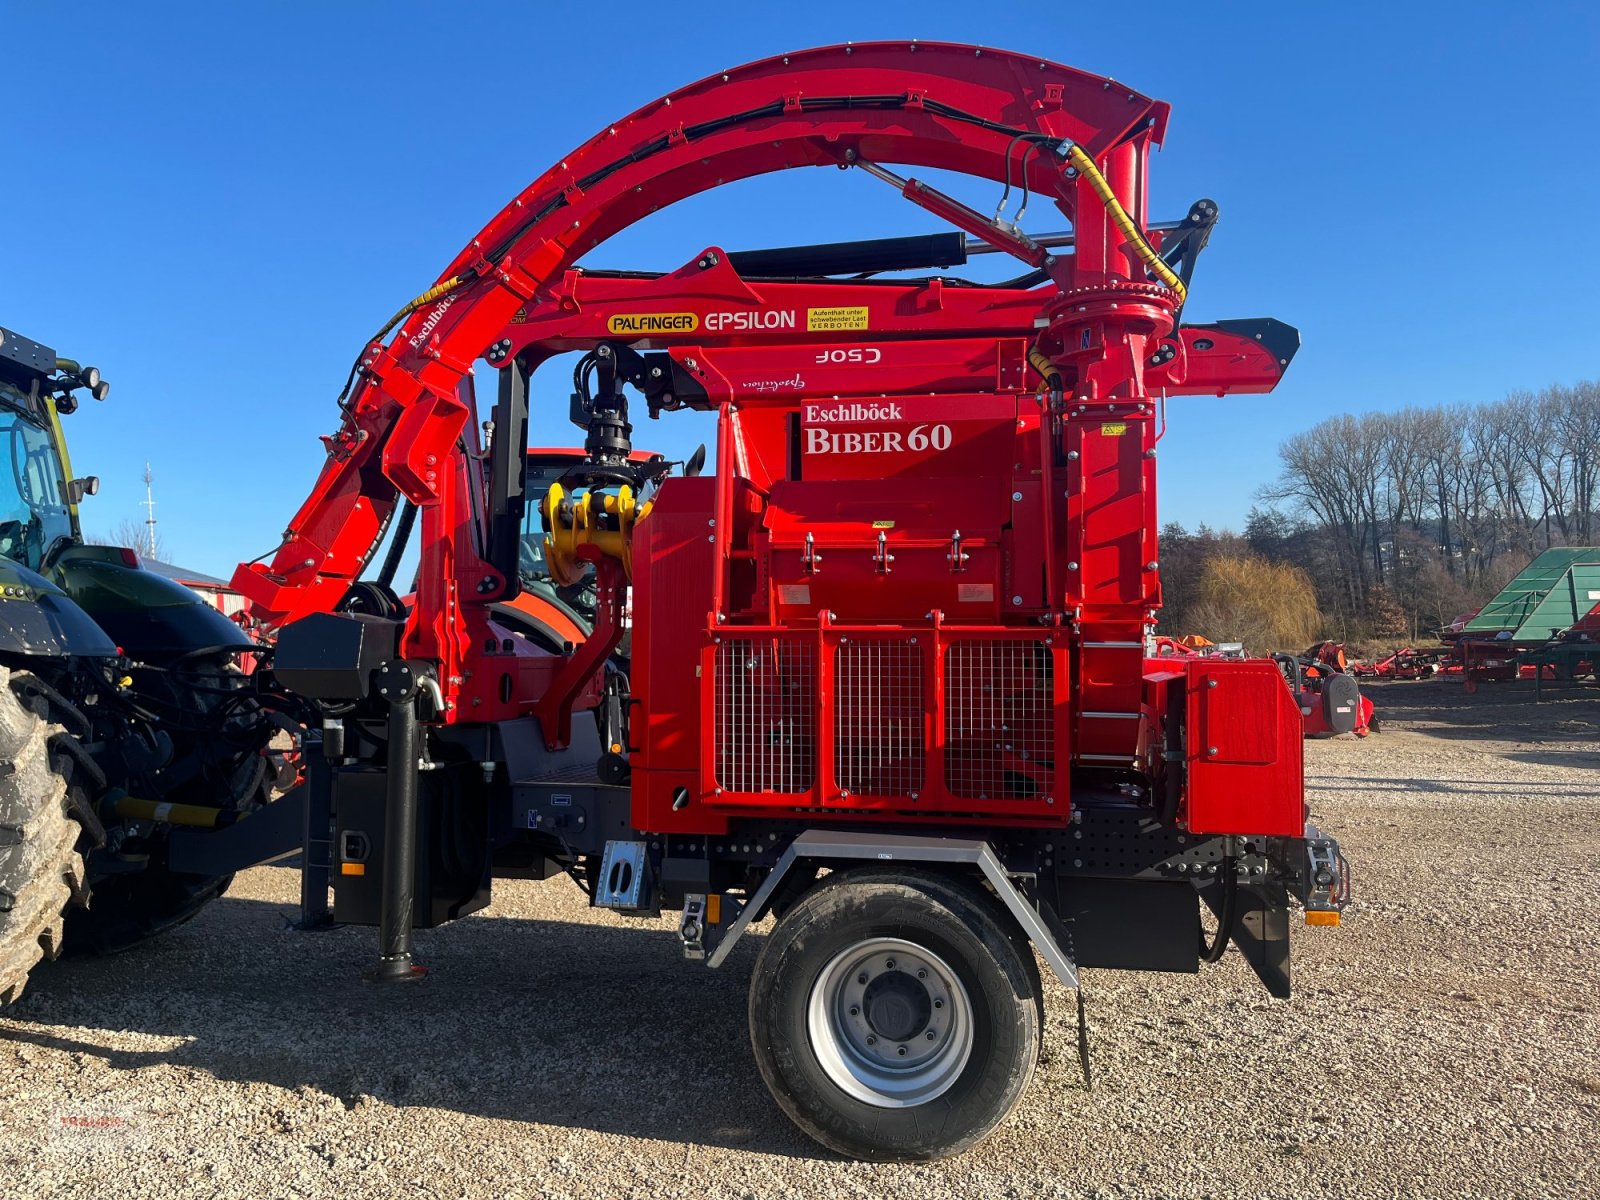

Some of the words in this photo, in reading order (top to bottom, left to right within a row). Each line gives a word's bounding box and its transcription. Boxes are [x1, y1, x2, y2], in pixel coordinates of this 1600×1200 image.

[613, 315, 693, 331] PALFINGER
[704, 310, 796, 331] EPSILON
[815, 348, 881, 364] C50F
[805, 402, 903, 423] Eschlböck
[804, 428, 905, 455] BIBER
[907, 424, 953, 452] 60
